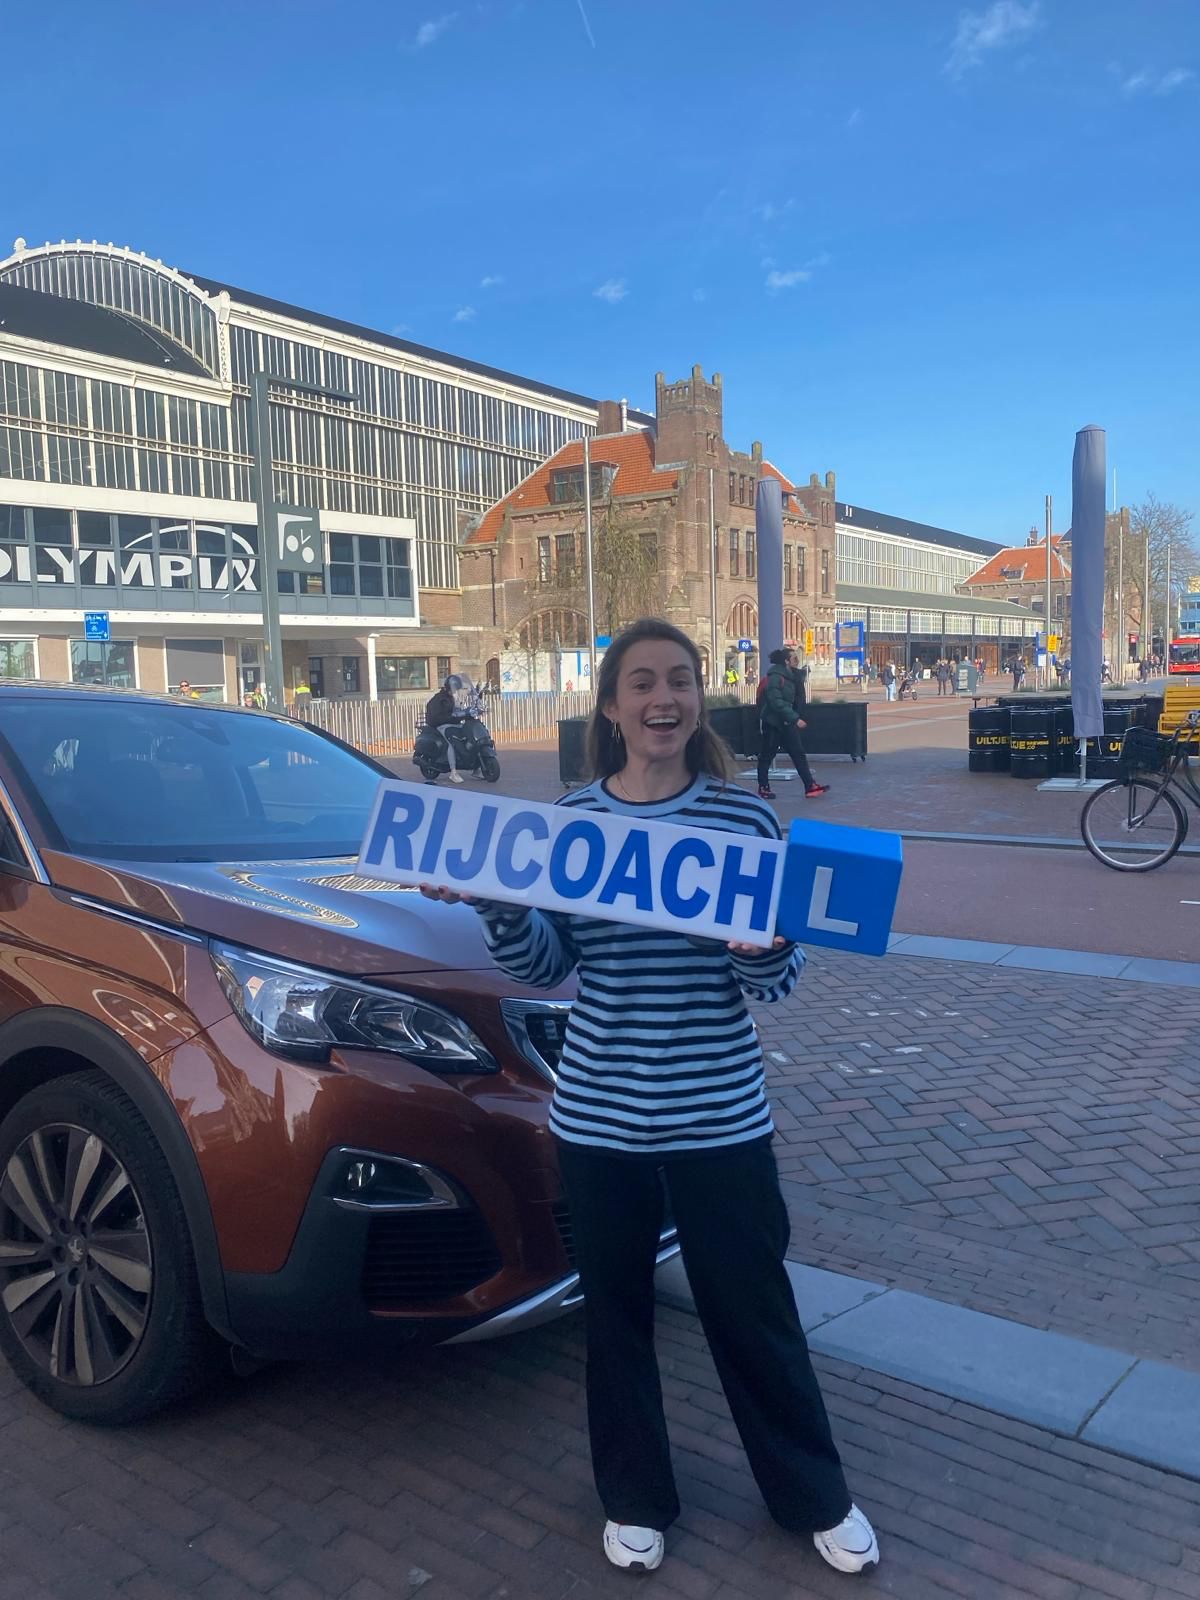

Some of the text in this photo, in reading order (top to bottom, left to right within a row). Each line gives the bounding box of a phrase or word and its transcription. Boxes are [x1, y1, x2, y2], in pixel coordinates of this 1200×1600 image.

[976, 736, 1007, 745] UILTJE
[365, 790, 779, 932] RIJCOACH
[807, 866, 859, 936] L
